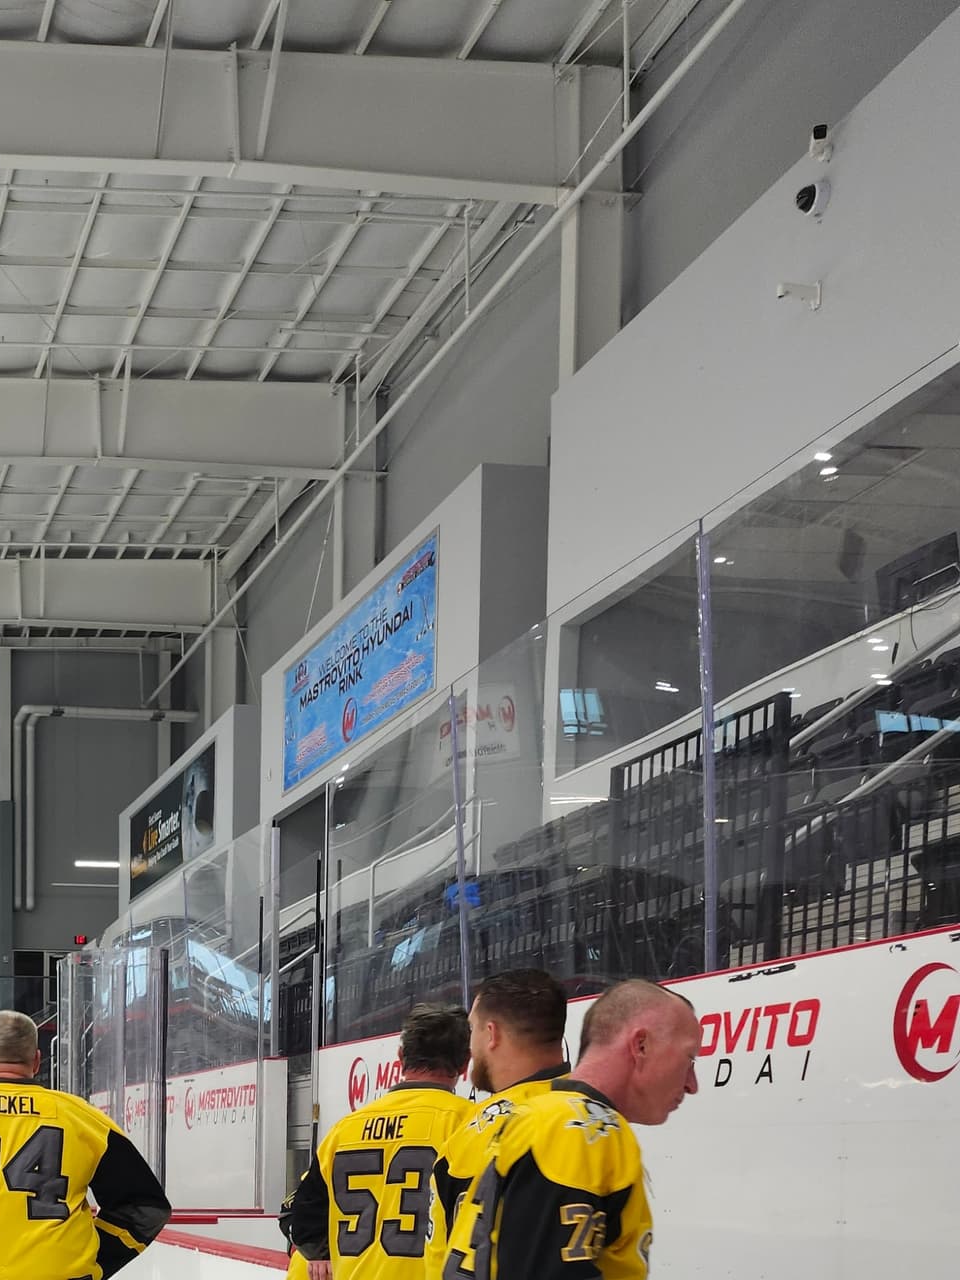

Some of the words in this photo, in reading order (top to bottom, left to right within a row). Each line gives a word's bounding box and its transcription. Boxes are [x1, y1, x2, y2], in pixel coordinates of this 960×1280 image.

[298, 647, 360, 712] MASTROVITO
[361, 600, 413, 660] HYUNDAI
[318, 633, 358, 676] WELCOME
[359, 624, 369, 640] TO
[370, 607, 388, 627] THE
[338, 662, 363, 697] RINK
[699, 998, 821, 1057] OVITO
[198, 1084, 256, 1111] MASTROVITO
[361, 1115, 409, 1141] HOWE
[331, 1145, 439, 1258] 53
